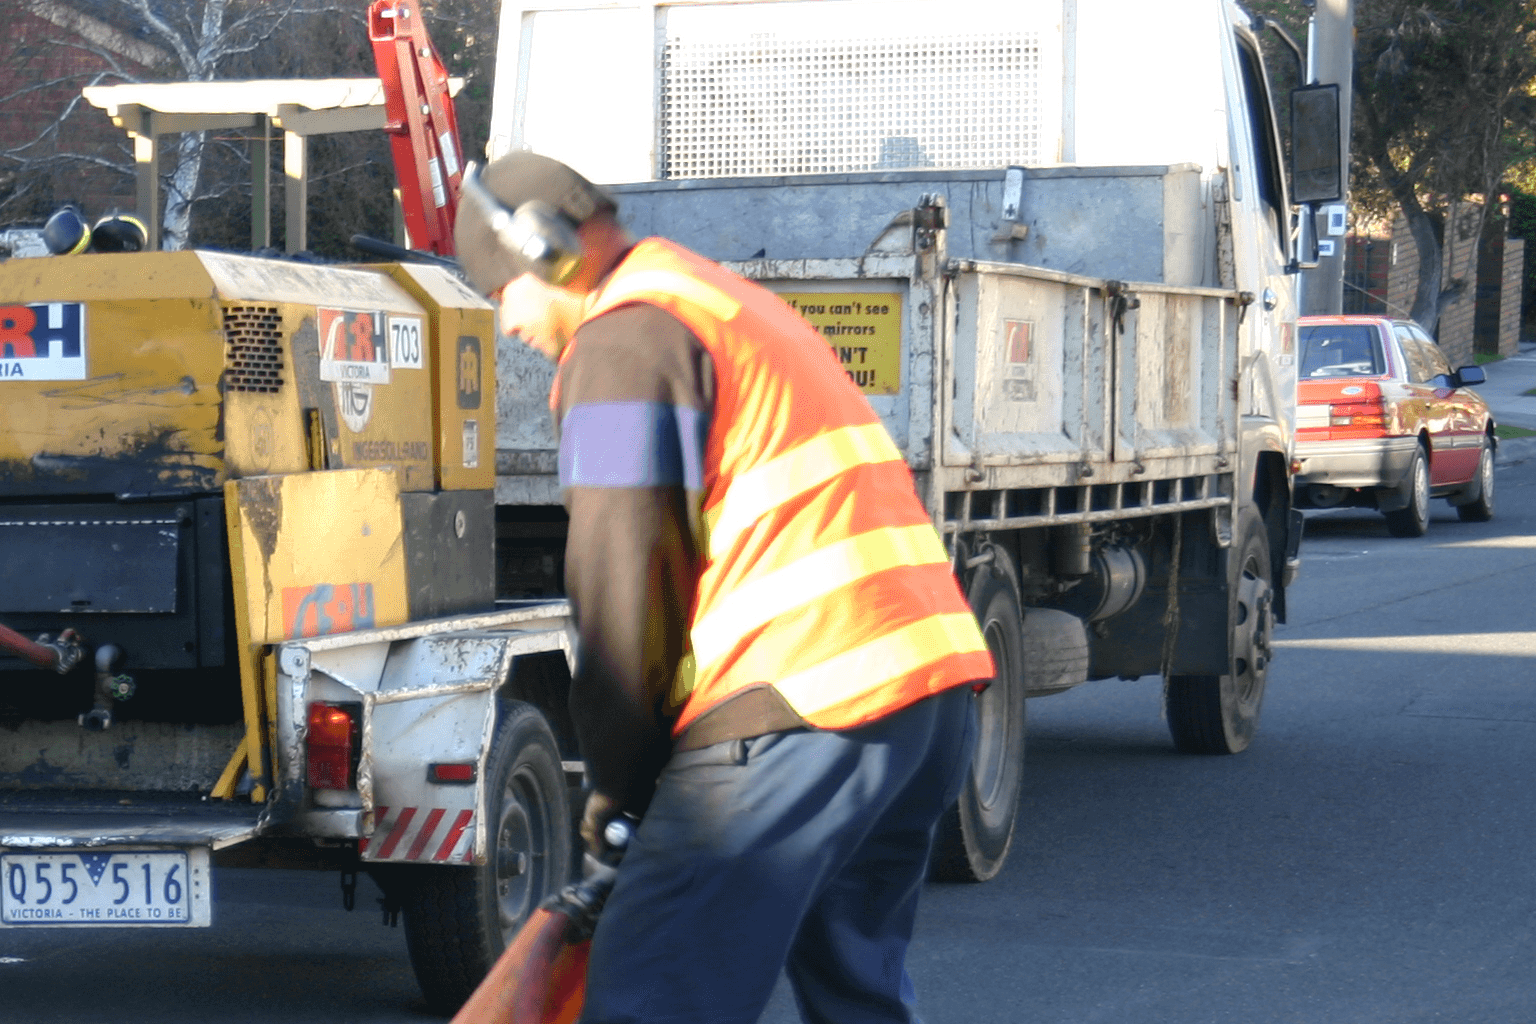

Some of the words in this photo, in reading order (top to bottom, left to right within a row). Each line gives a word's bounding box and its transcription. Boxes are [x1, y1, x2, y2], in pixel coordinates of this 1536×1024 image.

[800, 305, 826, 316] you
[829, 301, 862, 316] can't
[865, 305, 889, 315] see
[824, 321, 876, 335] mirrors
[392, 325, 420, 363] 703
[340, 364, 371, 380] VICTORIA
[9, 863, 78, 905] Q55
[113, 863, 182, 905] 516
[10, 908, 63, 918] VICTORIA
[80, 908, 101, 918] THE
[107, 908, 141, 918] PLACE
[147, 908, 161, 918] TO
[168, 908, 182, 918] BE
